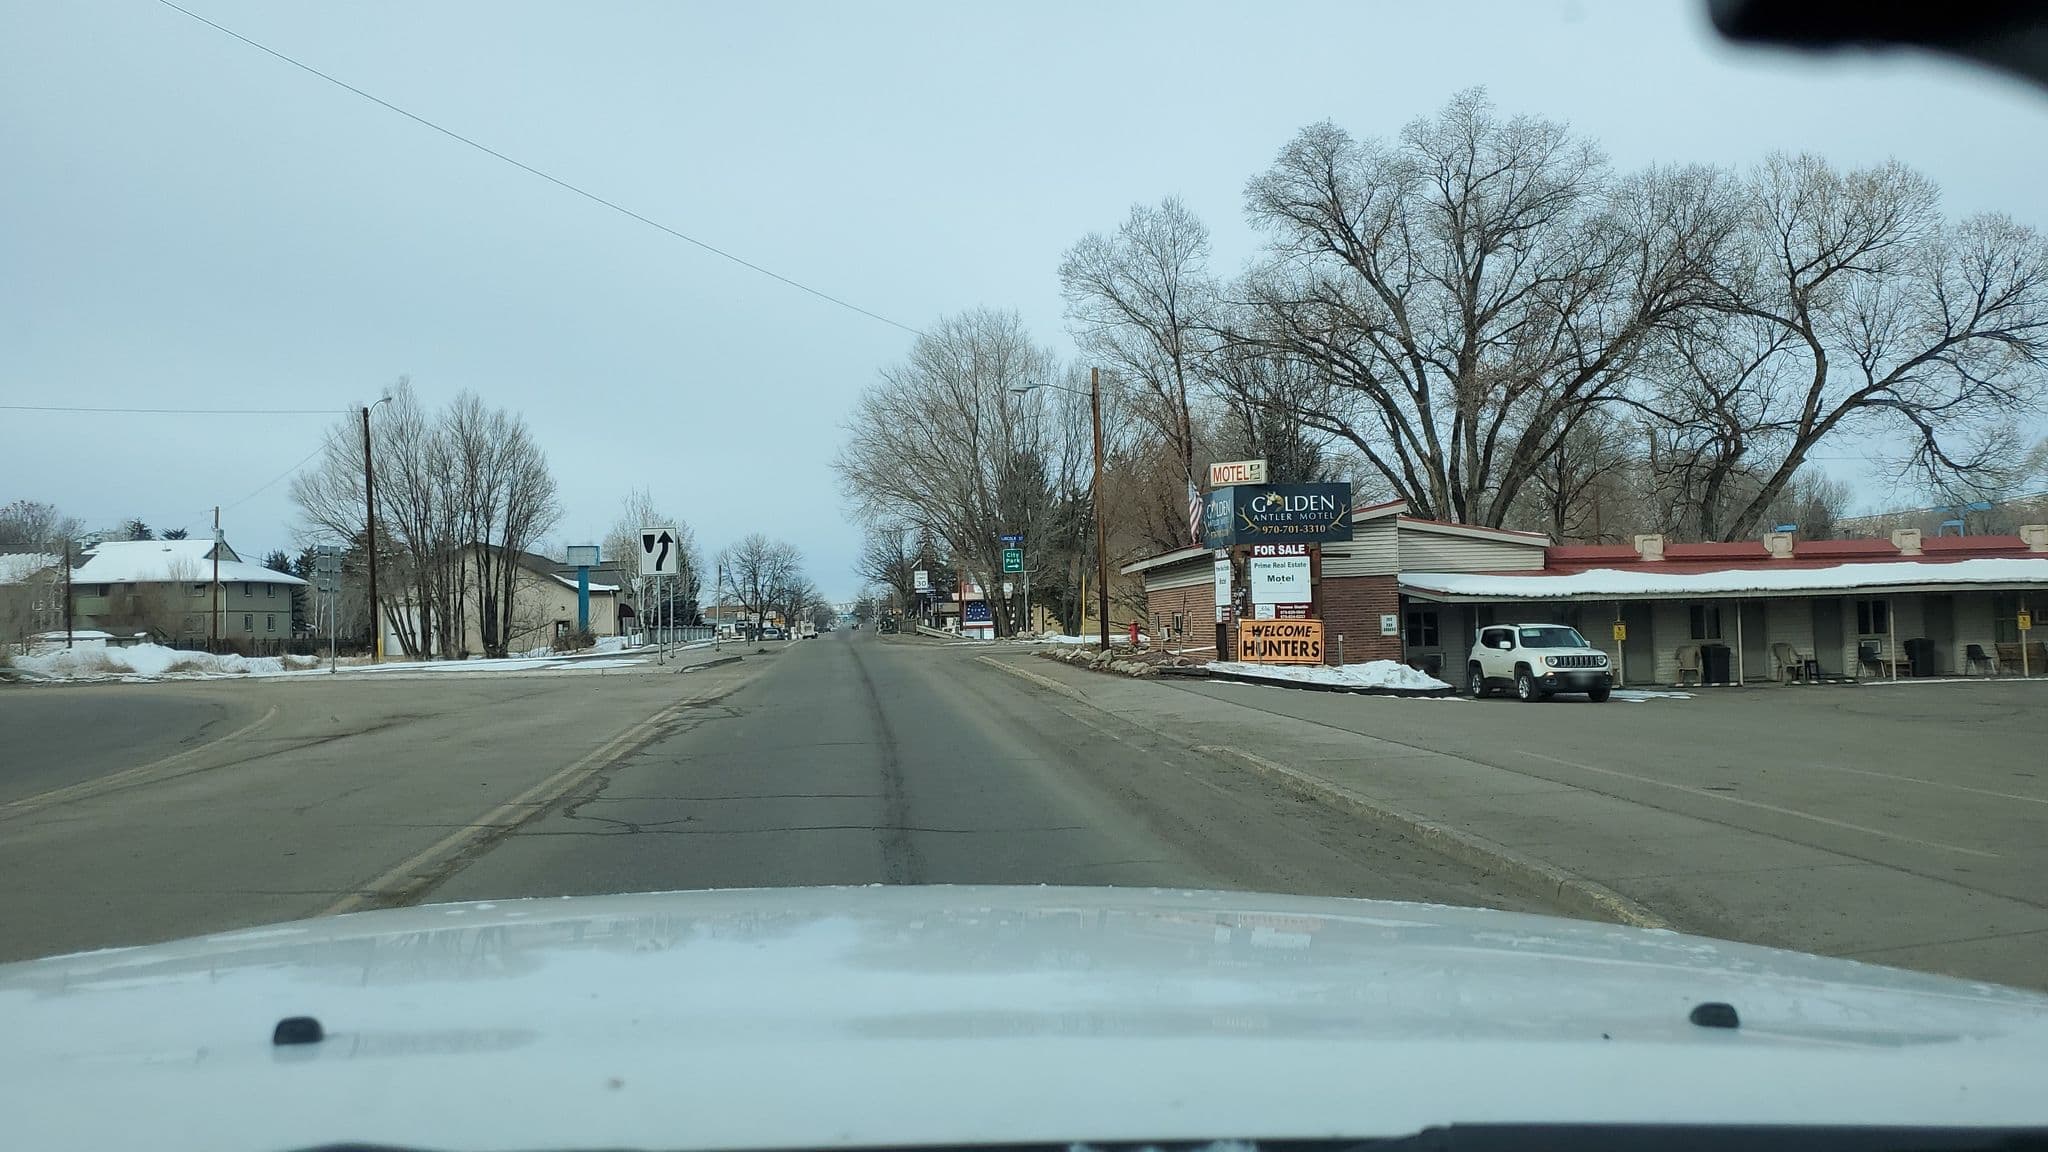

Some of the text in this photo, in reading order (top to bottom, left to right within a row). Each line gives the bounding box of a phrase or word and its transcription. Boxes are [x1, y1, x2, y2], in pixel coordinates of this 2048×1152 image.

[1213, 465, 1249, 482] MOTEL
[1252, 494, 1335, 513] GOLDEN
[1253, 512, 1334, 521] ANTLER MOTEL
[1262, 524, 1326, 534] 970-701-3310
[1006, 552, 1020, 560] City
[1254, 544, 1305, 556] FOR SALE
[1267, 574, 1294, 582] Motel
[1252, 625, 1312, 637] WELCOME
[1243, 640, 1320, 657] HUNTERS
